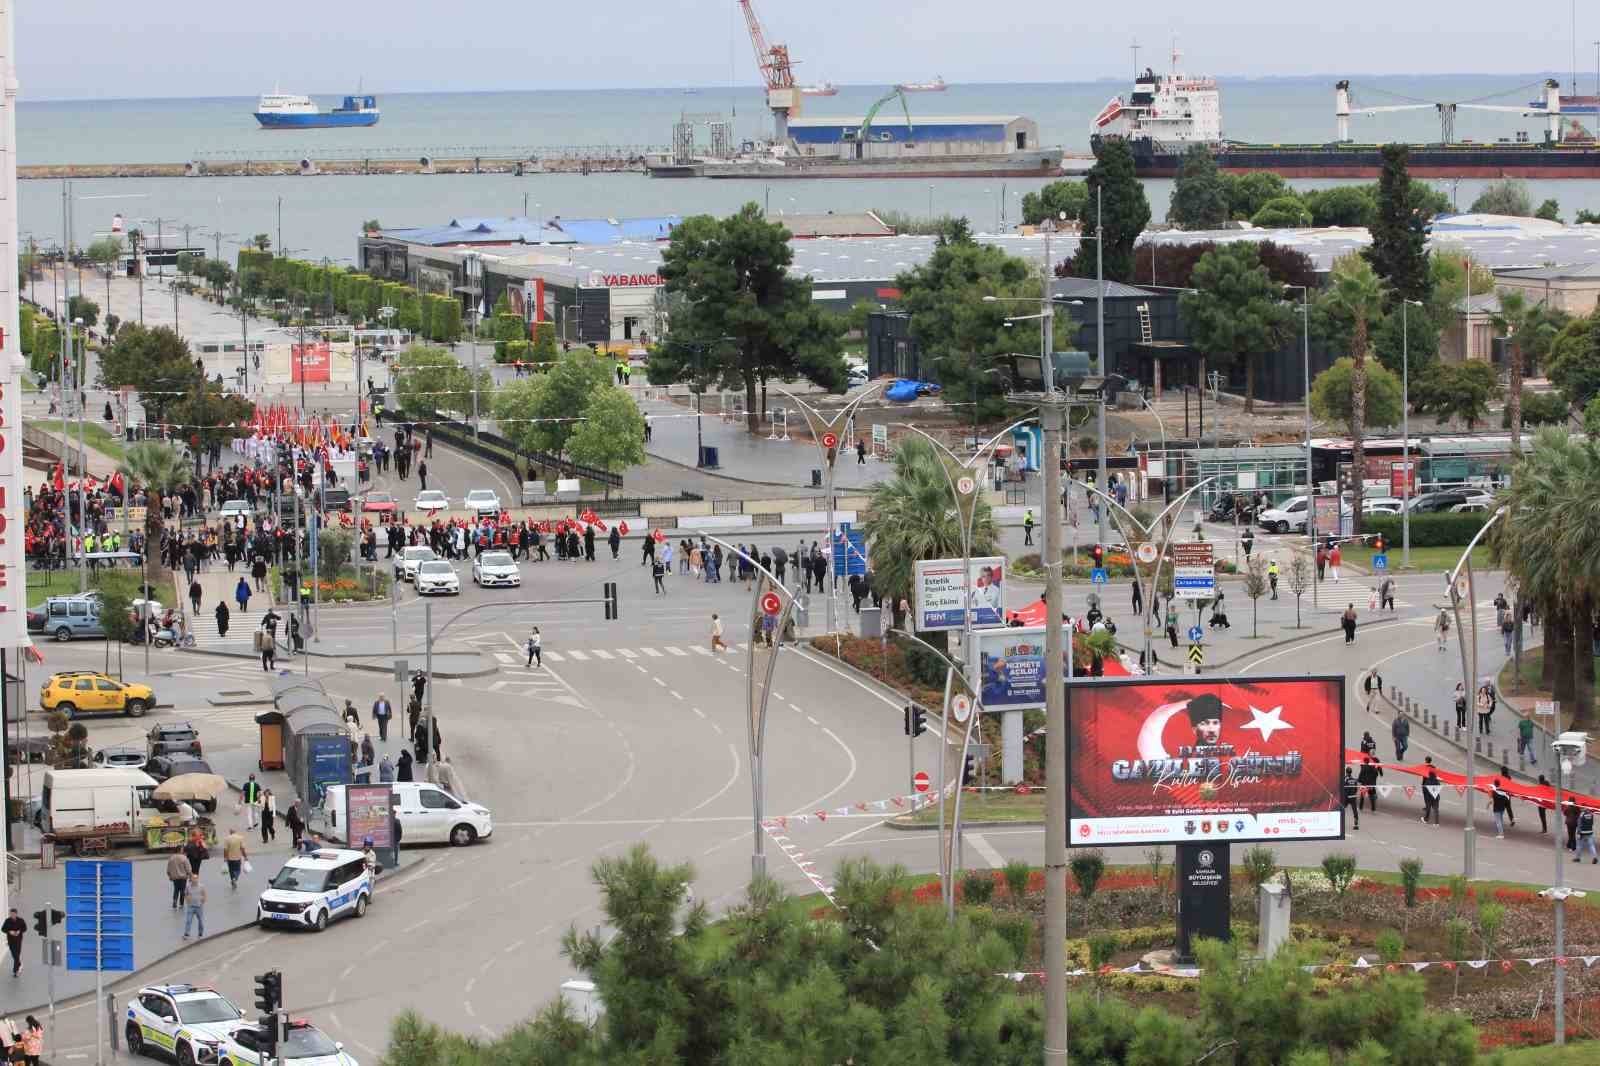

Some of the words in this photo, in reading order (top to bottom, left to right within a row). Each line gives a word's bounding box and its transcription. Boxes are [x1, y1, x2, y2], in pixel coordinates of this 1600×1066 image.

[925, 576, 950, 585] Estetik
[1112, 756, 1220, 781] GAZİLER
[1152, 766, 1200, 795] Kutlu
